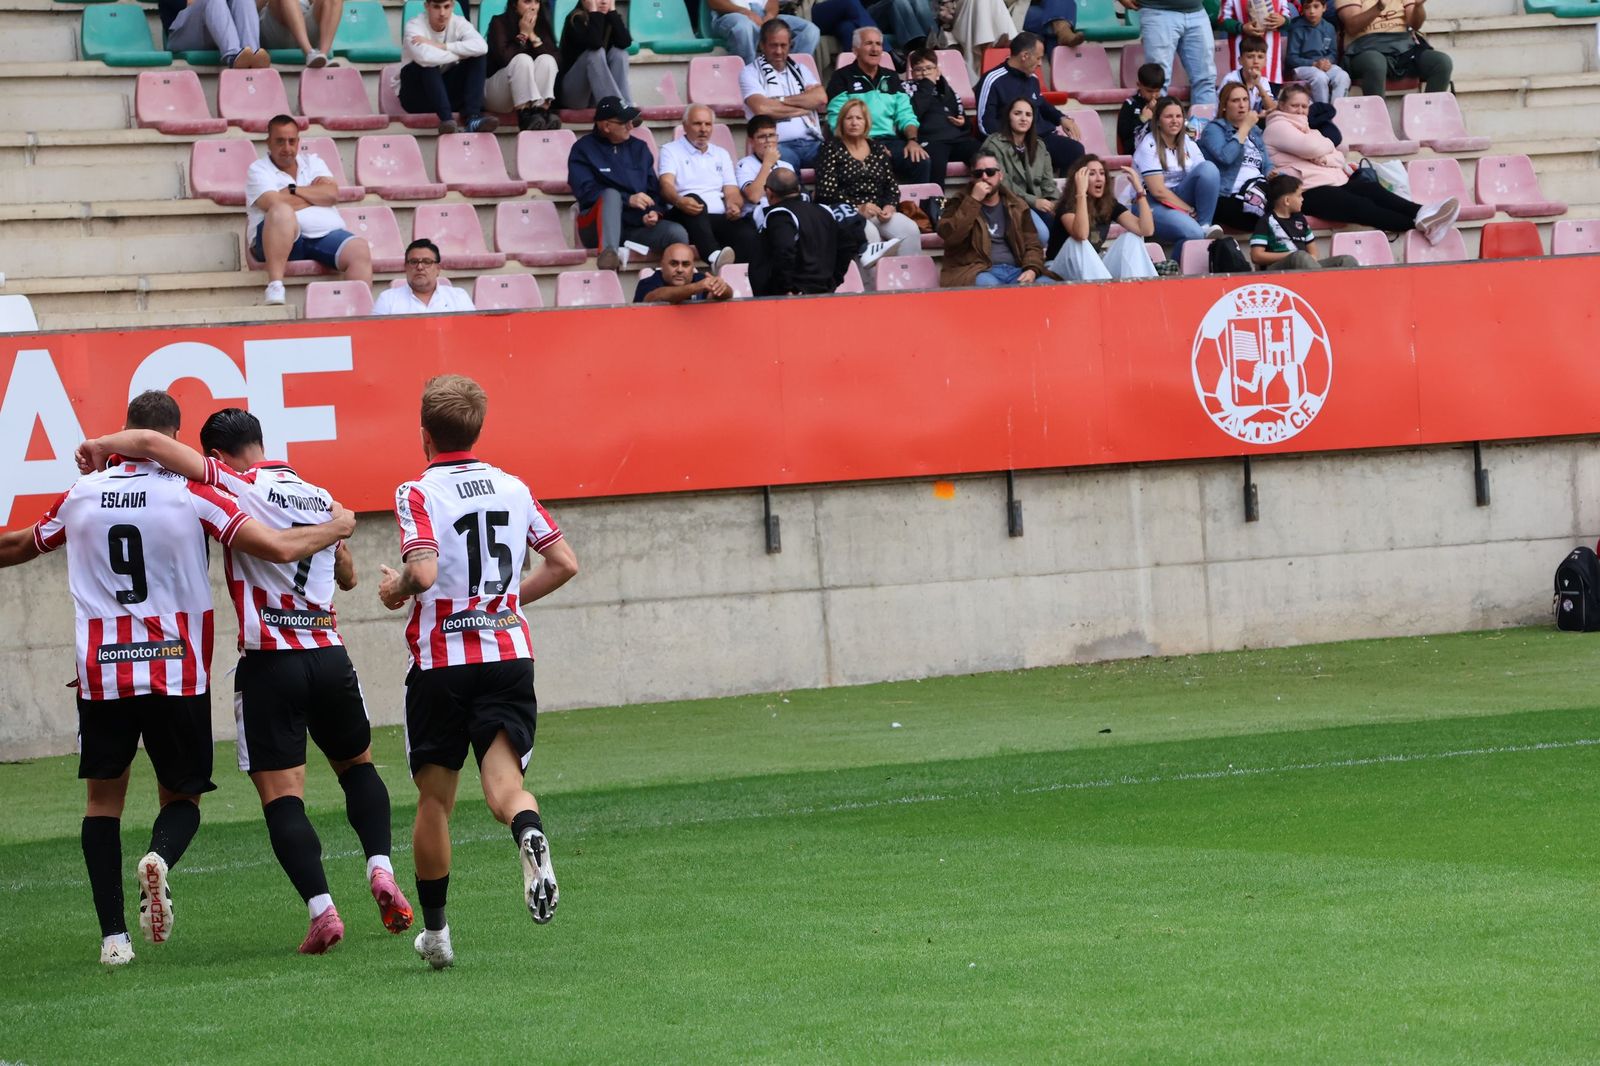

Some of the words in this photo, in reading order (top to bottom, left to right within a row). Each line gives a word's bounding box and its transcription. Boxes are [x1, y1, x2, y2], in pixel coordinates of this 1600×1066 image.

[1214, 412, 1287, 442] ZAMORA
[455, 478, 496, 499] LOREN
[101, 490, 148, 509] ESLAVA
[108, 523, 148, 604] 9
[452, 510, 514, 597] 15
[261, 606, 333, 627] leomotor.net
[443, 612, 520, 631] leomotor.net
[98, 644, 184, 661] leomotor.net
